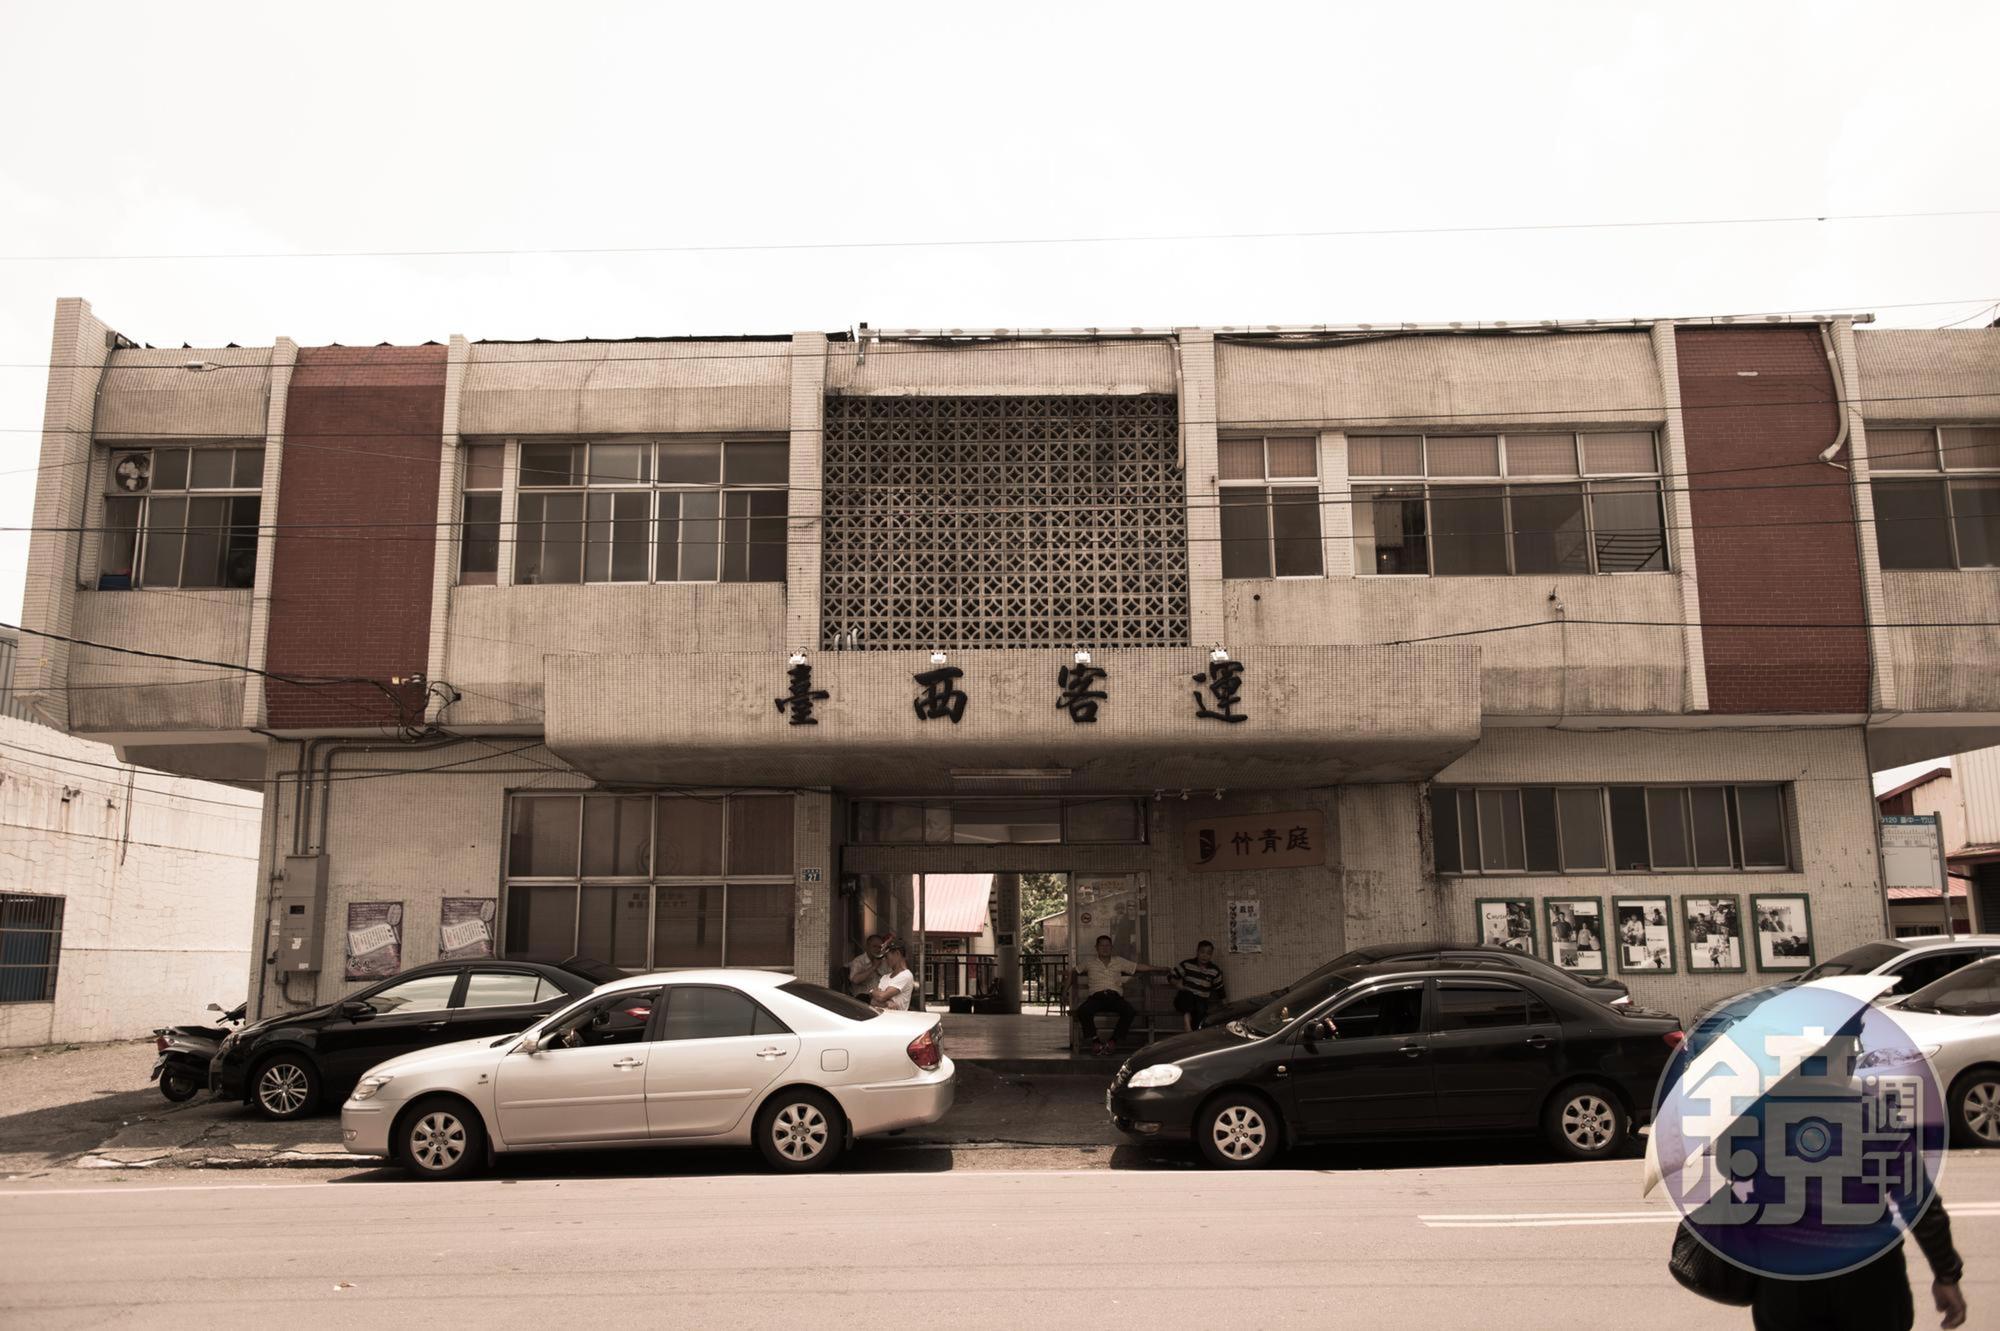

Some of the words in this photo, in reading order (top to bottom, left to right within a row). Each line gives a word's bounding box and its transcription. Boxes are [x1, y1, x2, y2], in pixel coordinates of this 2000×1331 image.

[775, 661, 1248, 725] 臺西客運
[1230, 825, 1312, 856] 竹青庭
[807, 873, 817, 882] 27
